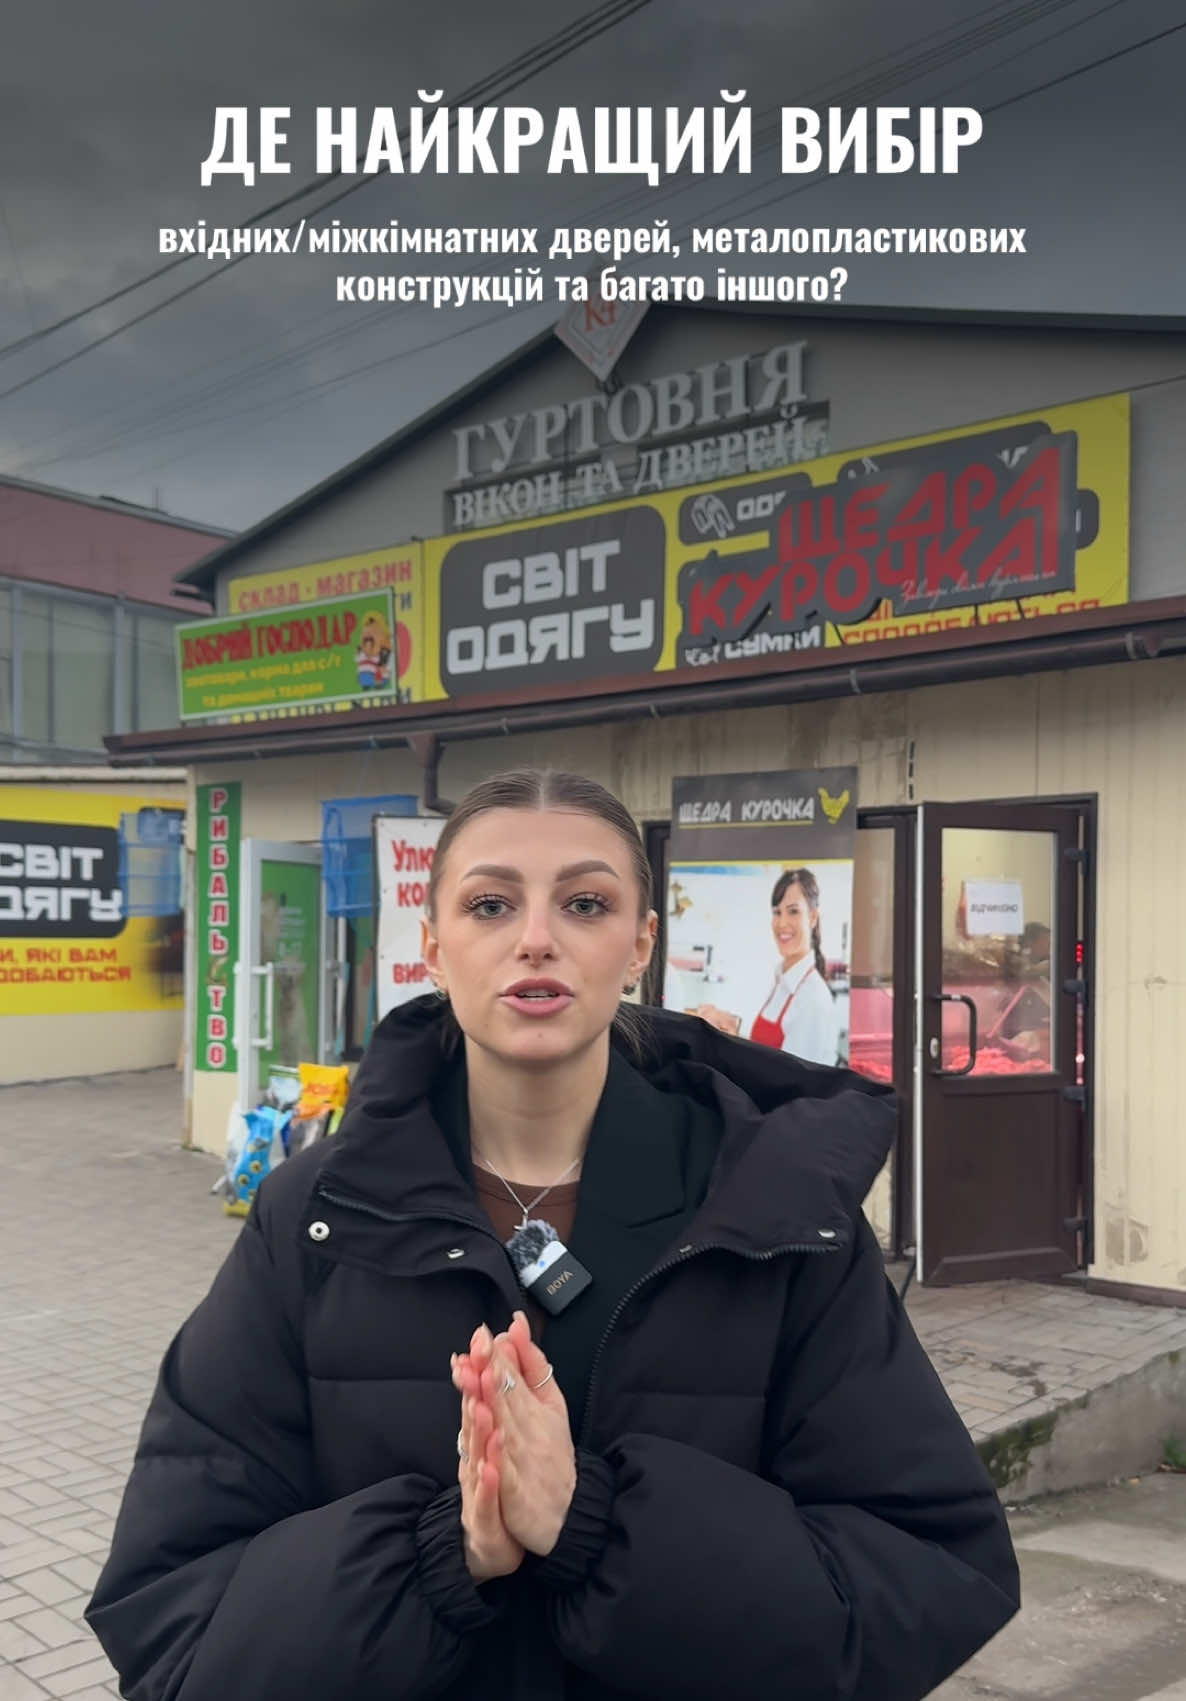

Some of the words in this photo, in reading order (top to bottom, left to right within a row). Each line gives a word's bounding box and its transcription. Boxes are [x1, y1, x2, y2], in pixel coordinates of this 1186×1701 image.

[453, 341, 808, 480] ГУРТОВНЯ
[453, 471, 563, 526] ВІКОН
[576, 459, 624, 498] ТА
[633, 404, 807, 494] ДВЕРЕЙ
[482, 539, 621, 610] СВІТ
[688, 517, 1042, 637] КУРОЧКА
[256, 610, 358, 659] ГОСПОДАР
[446, 598, 655, 675] ОДЯГУ
[740, 797, 815, 822] КУРОЧКА
[0, 842, 104, 881] СВІТ
[26, 948, 61, 963] ЯКІ
[69, 948, 118, 963] ВАМ
[545, 1270, 575, 1296] BOYA
